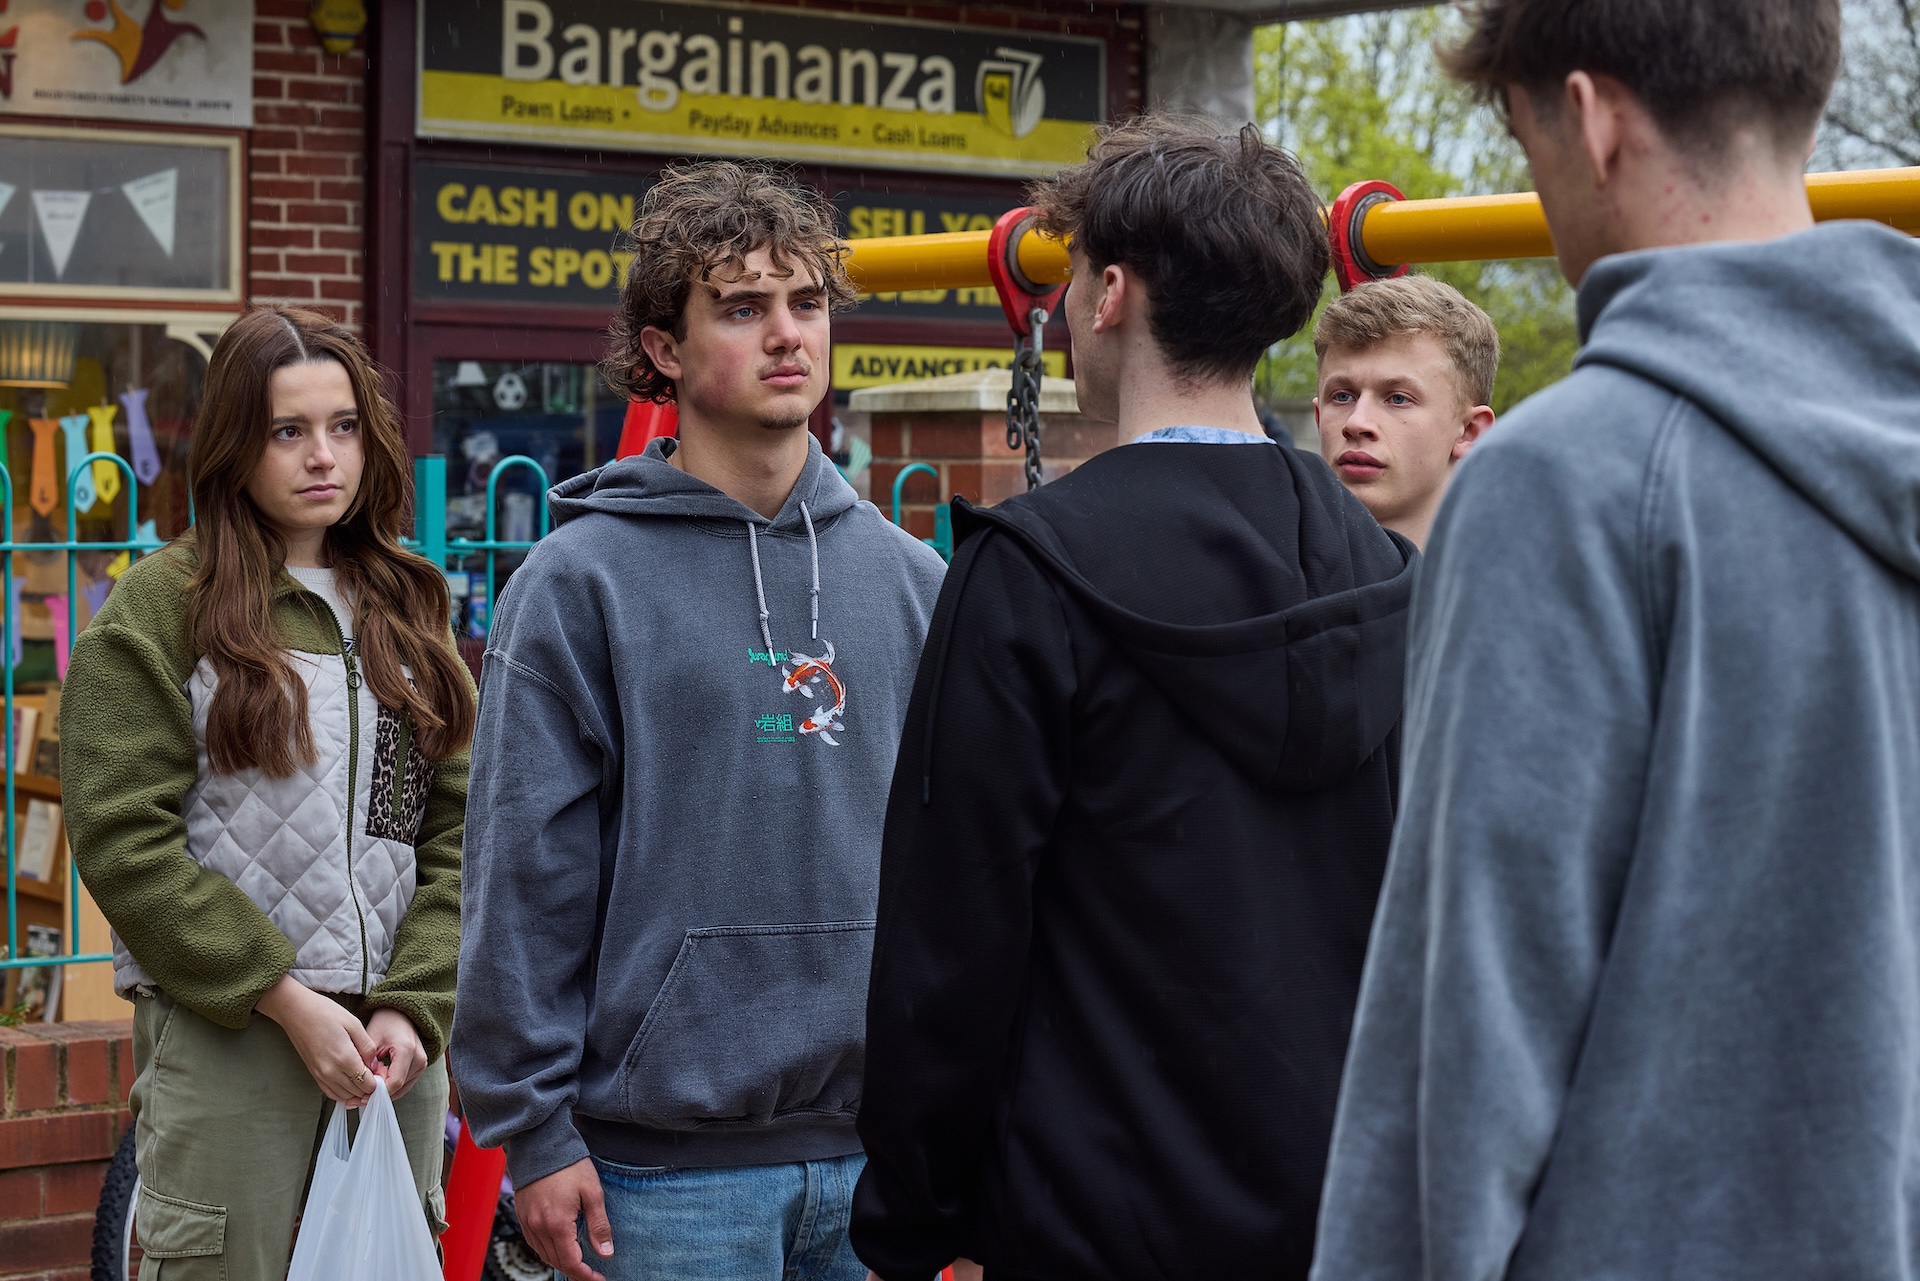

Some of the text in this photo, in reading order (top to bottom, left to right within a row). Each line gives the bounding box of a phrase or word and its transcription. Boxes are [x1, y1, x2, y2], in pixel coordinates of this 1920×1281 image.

[501, 0, 957, 112] Bargainanza
[501, 95, 967, 149] Pawn Loans Payday Advances Cash Loans
[436, 181, 636, 232] CASH ON
[430, 240, 637, 290] THE SPOT
[851, 355, 964, 379] ADVANCE
